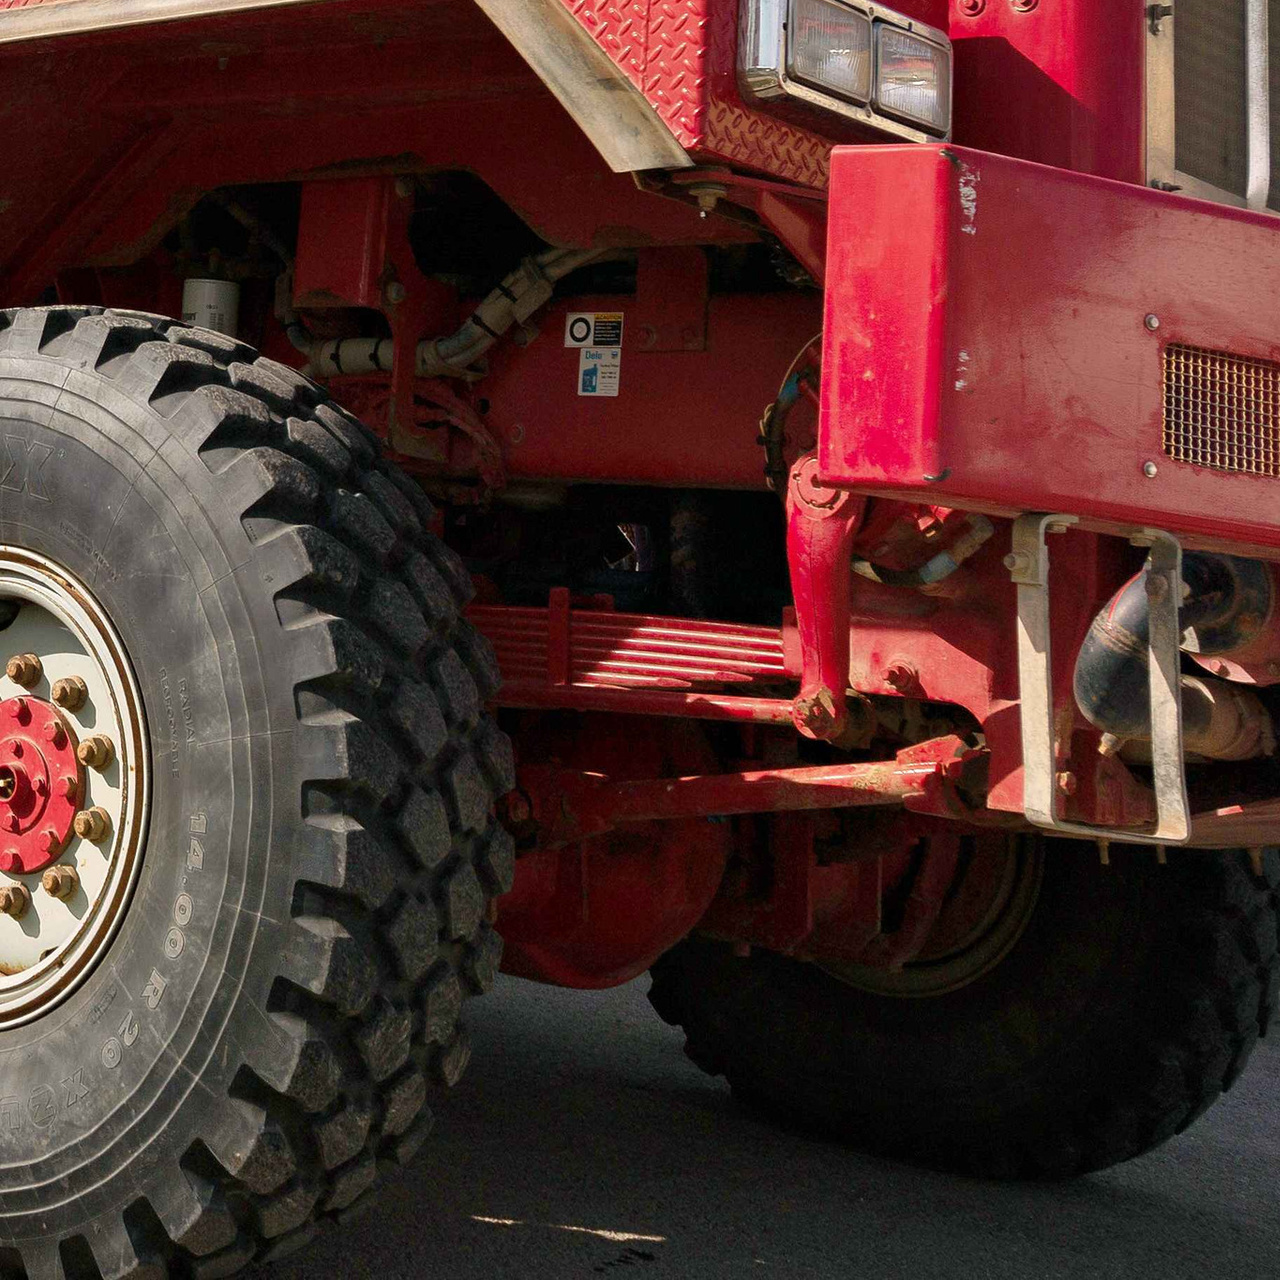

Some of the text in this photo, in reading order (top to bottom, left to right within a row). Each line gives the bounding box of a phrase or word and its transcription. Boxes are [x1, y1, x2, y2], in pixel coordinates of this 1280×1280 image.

[164, 812, 208, 960] 14.00
[140, 966, 168, 1010] R
[100, 1009, 139, 1069] 20
